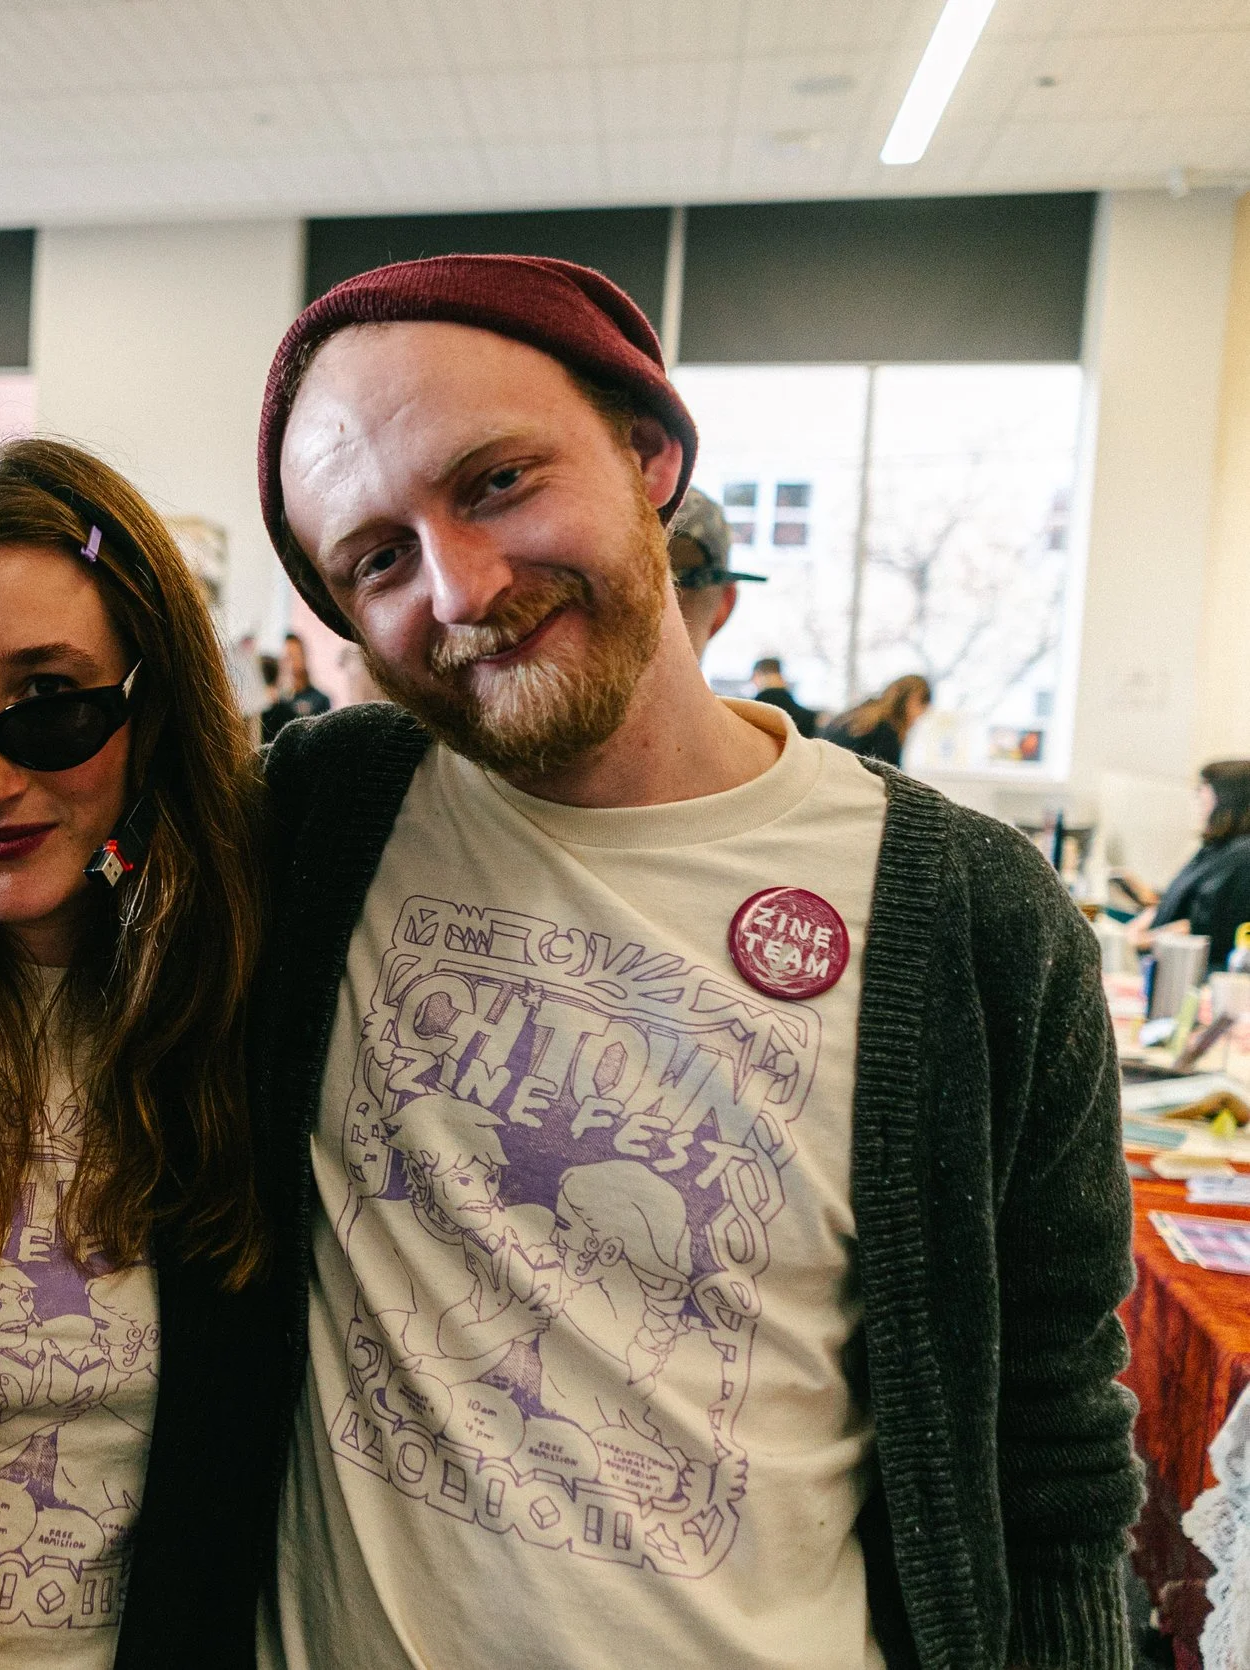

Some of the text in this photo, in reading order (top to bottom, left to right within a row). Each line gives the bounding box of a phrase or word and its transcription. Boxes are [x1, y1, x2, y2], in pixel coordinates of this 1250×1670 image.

[753, 904, 833, 949] ZINE
[744, 931, 830, 978] TEAM
[390, 1045, 756, 1189] ZINE FEST
[467, 1400, 497, 1417] 10am
[37, 1533, 87, 1550] ADMISSION
[49, 1528, 74, 1540] FREE
